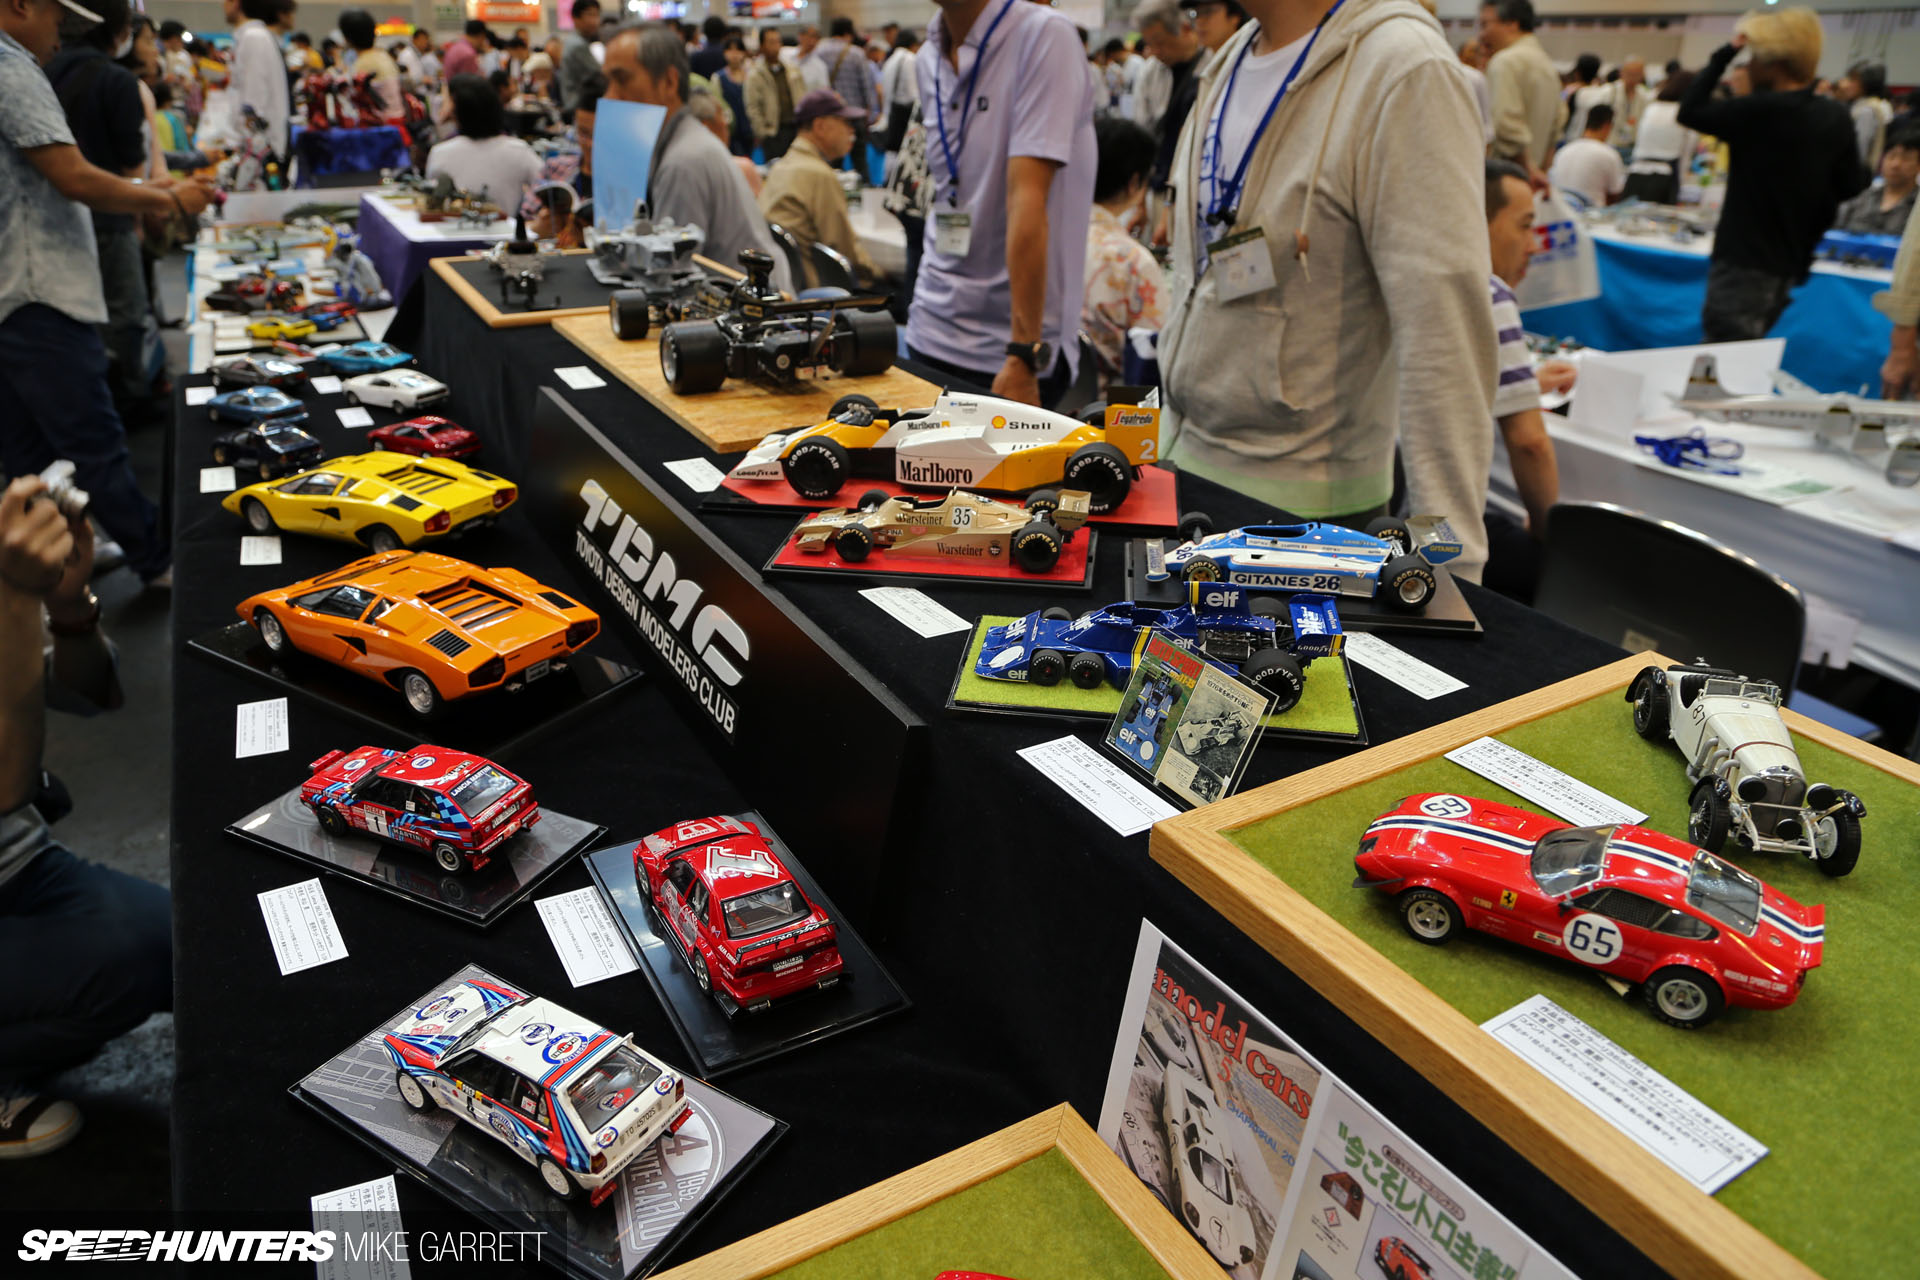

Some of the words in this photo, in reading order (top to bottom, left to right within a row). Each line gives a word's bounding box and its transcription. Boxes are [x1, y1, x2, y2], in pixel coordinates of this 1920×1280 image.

[907, 421, 941, 431] Marlboro
[1009, 421, 1051, 430] Shell
[1111, 410, 1154, 426] Segafredo
[1139, 438, 1156, 460] 2
[900, 459, 973, 484] Marlboro
[953, 508, 972, 525] 35
[937, 542, 984, 557] Warsteiner
[1235, 573, 1310, 587] GITANES
[1312, 575, 1341, 590] 26
[1206, 591, 1239, 608] elf
[576, 530, 603, 582] TOYOTA
[605, 565, 639, 621] DESIGN
[639, 607, 699, 693] MODELERS
[699, 676, 735, 735] CLUB
[1005, 616, 1027, 639] elf
[1173, 637, 1195, 650] elf
[1007, 669, 1028, 680] elf
[1119, 727, 1138, 745] elf
[451, 780, 472, 797] LANCIA
[470, 765, 492, 783] MARTINI
[1424, 797, 1468, 816] 65
[373, 816, 381, 833] 1
[392, 826, 424, 843] MARTINI
[1570, 919, 1617, 958] 65
[1154, 965, 1248, 1064] model
[1246, 1049, 1312, 1120] cars
[1217, 1057, 1233, 1084] 5
[661, 1103, 687, 1129] MICHELIN
[1226, 1099, 1280, 1153] CHAPARRAL
[665, 1133, 709, 1157] 4
[602, 1152, 634, 1181] MICHELIN
[675, 1171, 709, 1202] 1992
